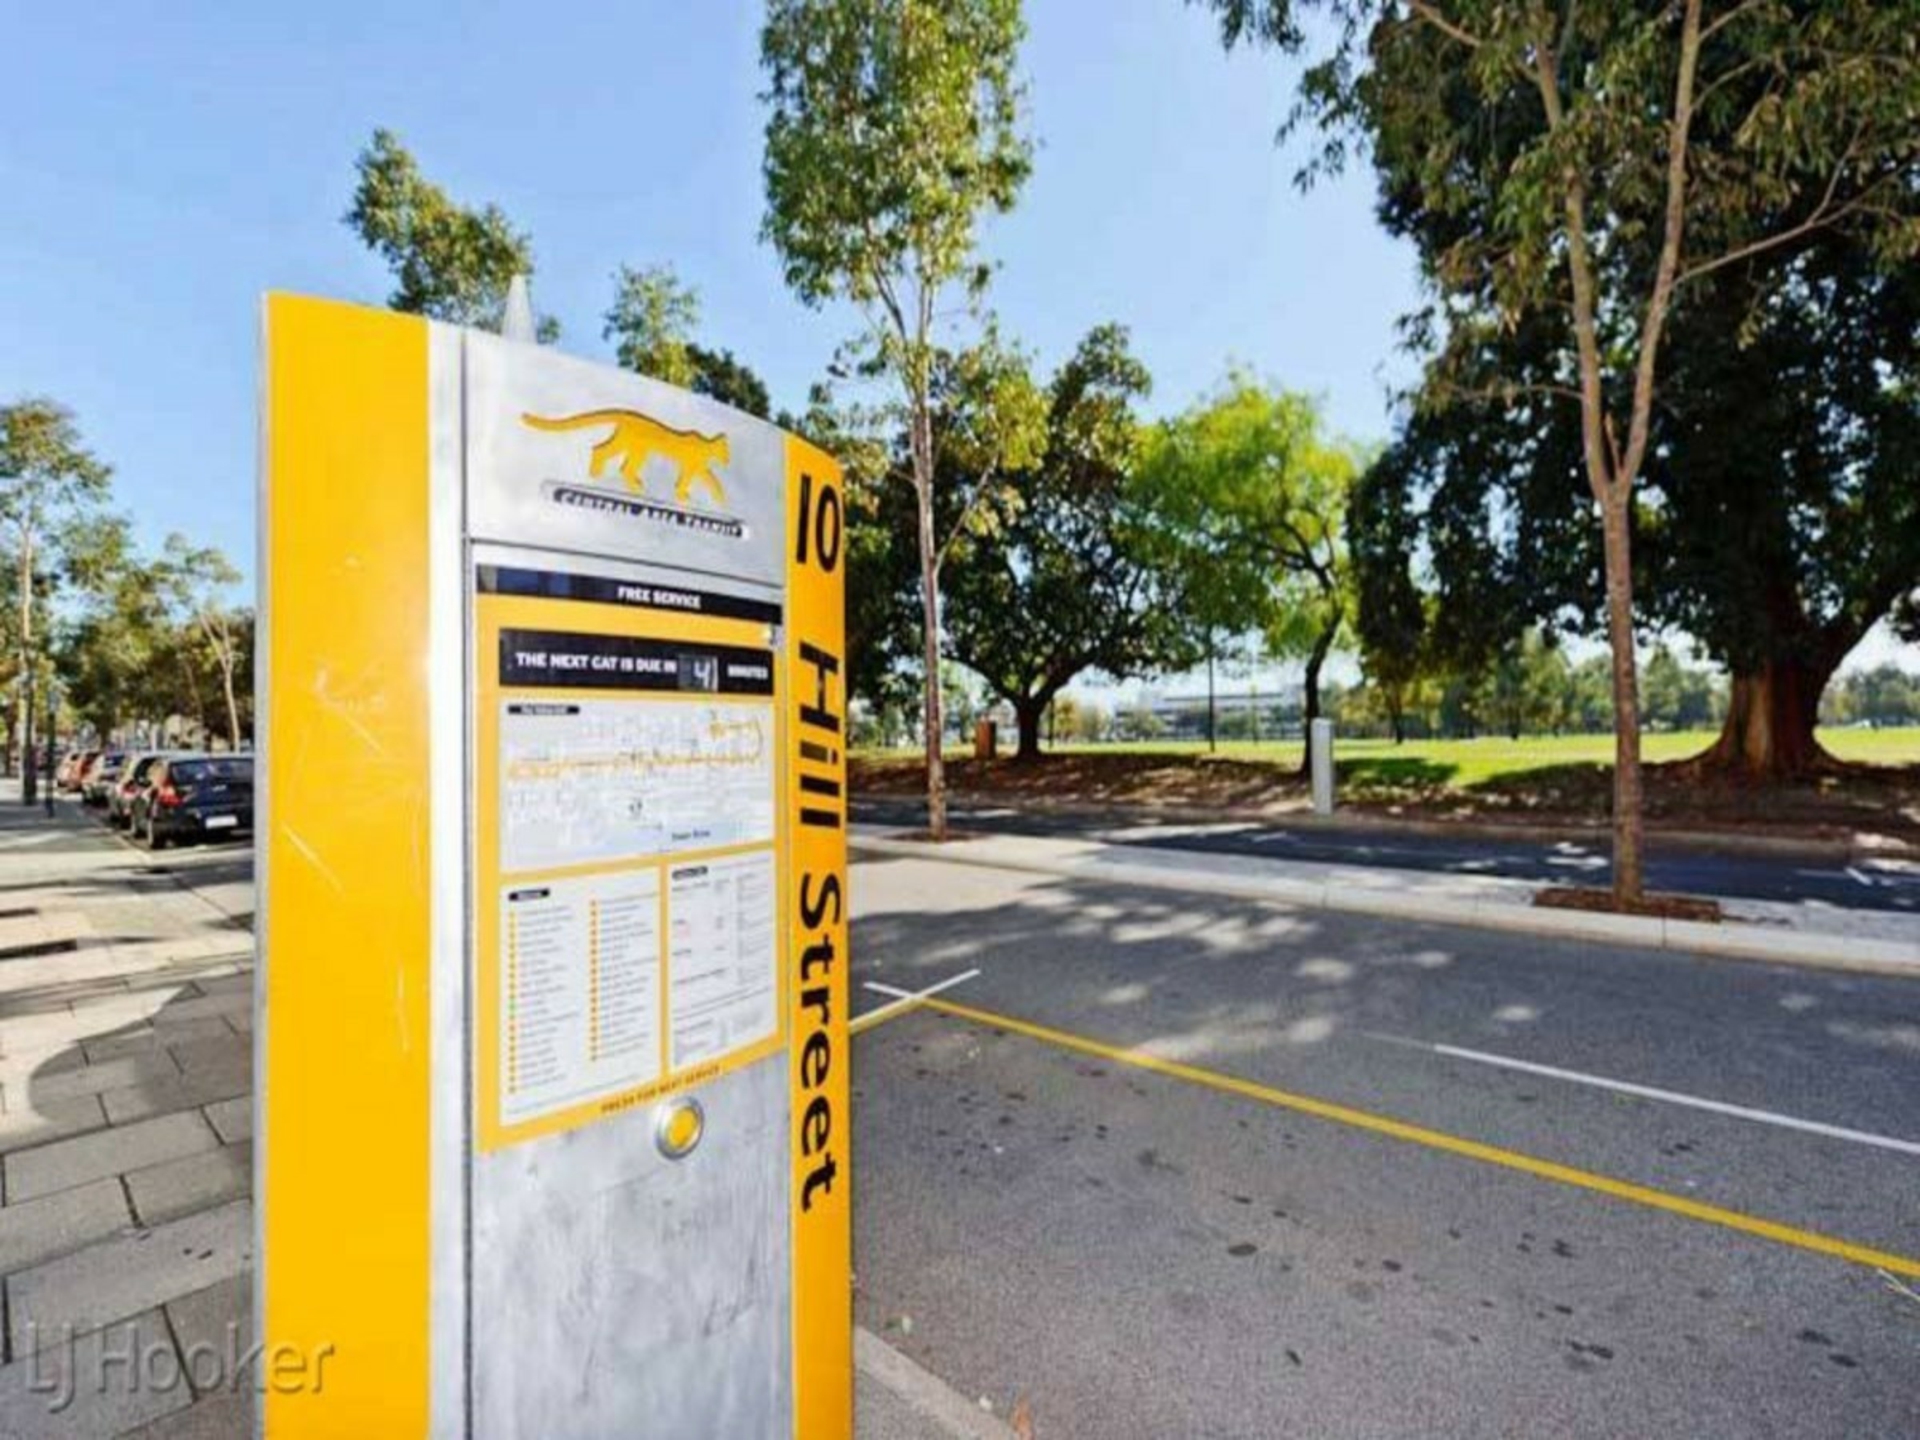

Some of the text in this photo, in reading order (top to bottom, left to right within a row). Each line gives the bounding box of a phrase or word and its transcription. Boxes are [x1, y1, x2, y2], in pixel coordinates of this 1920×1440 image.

[796, 473, 840, 573] 10
[617, 585, 701, 609] FREE SERVICE
[516, 652, 677, 673] THE NEXT CAT IS DUE IN
[799, 640, 840, 1212] Hill Street
